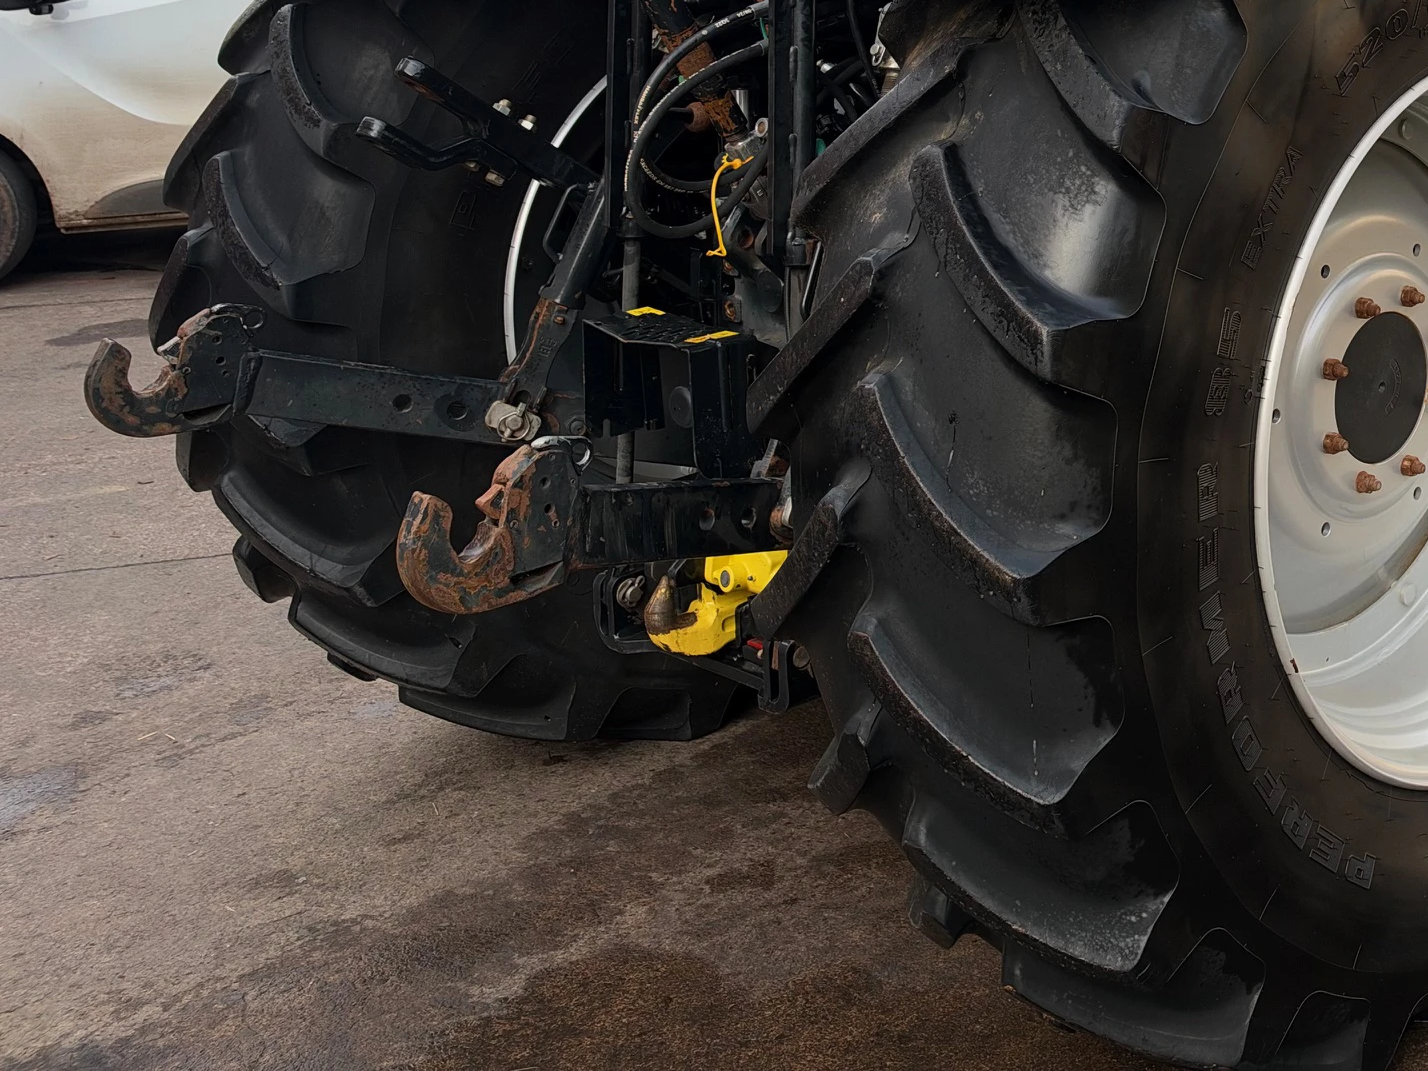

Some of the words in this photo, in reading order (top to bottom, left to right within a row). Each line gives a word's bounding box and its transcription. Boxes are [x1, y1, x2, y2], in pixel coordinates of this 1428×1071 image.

[1241, 145, 1301, 270] EXTRA
[1205, 307, 1241, 417] 85
[1197, 462, 1377, 889] PERFORMER
